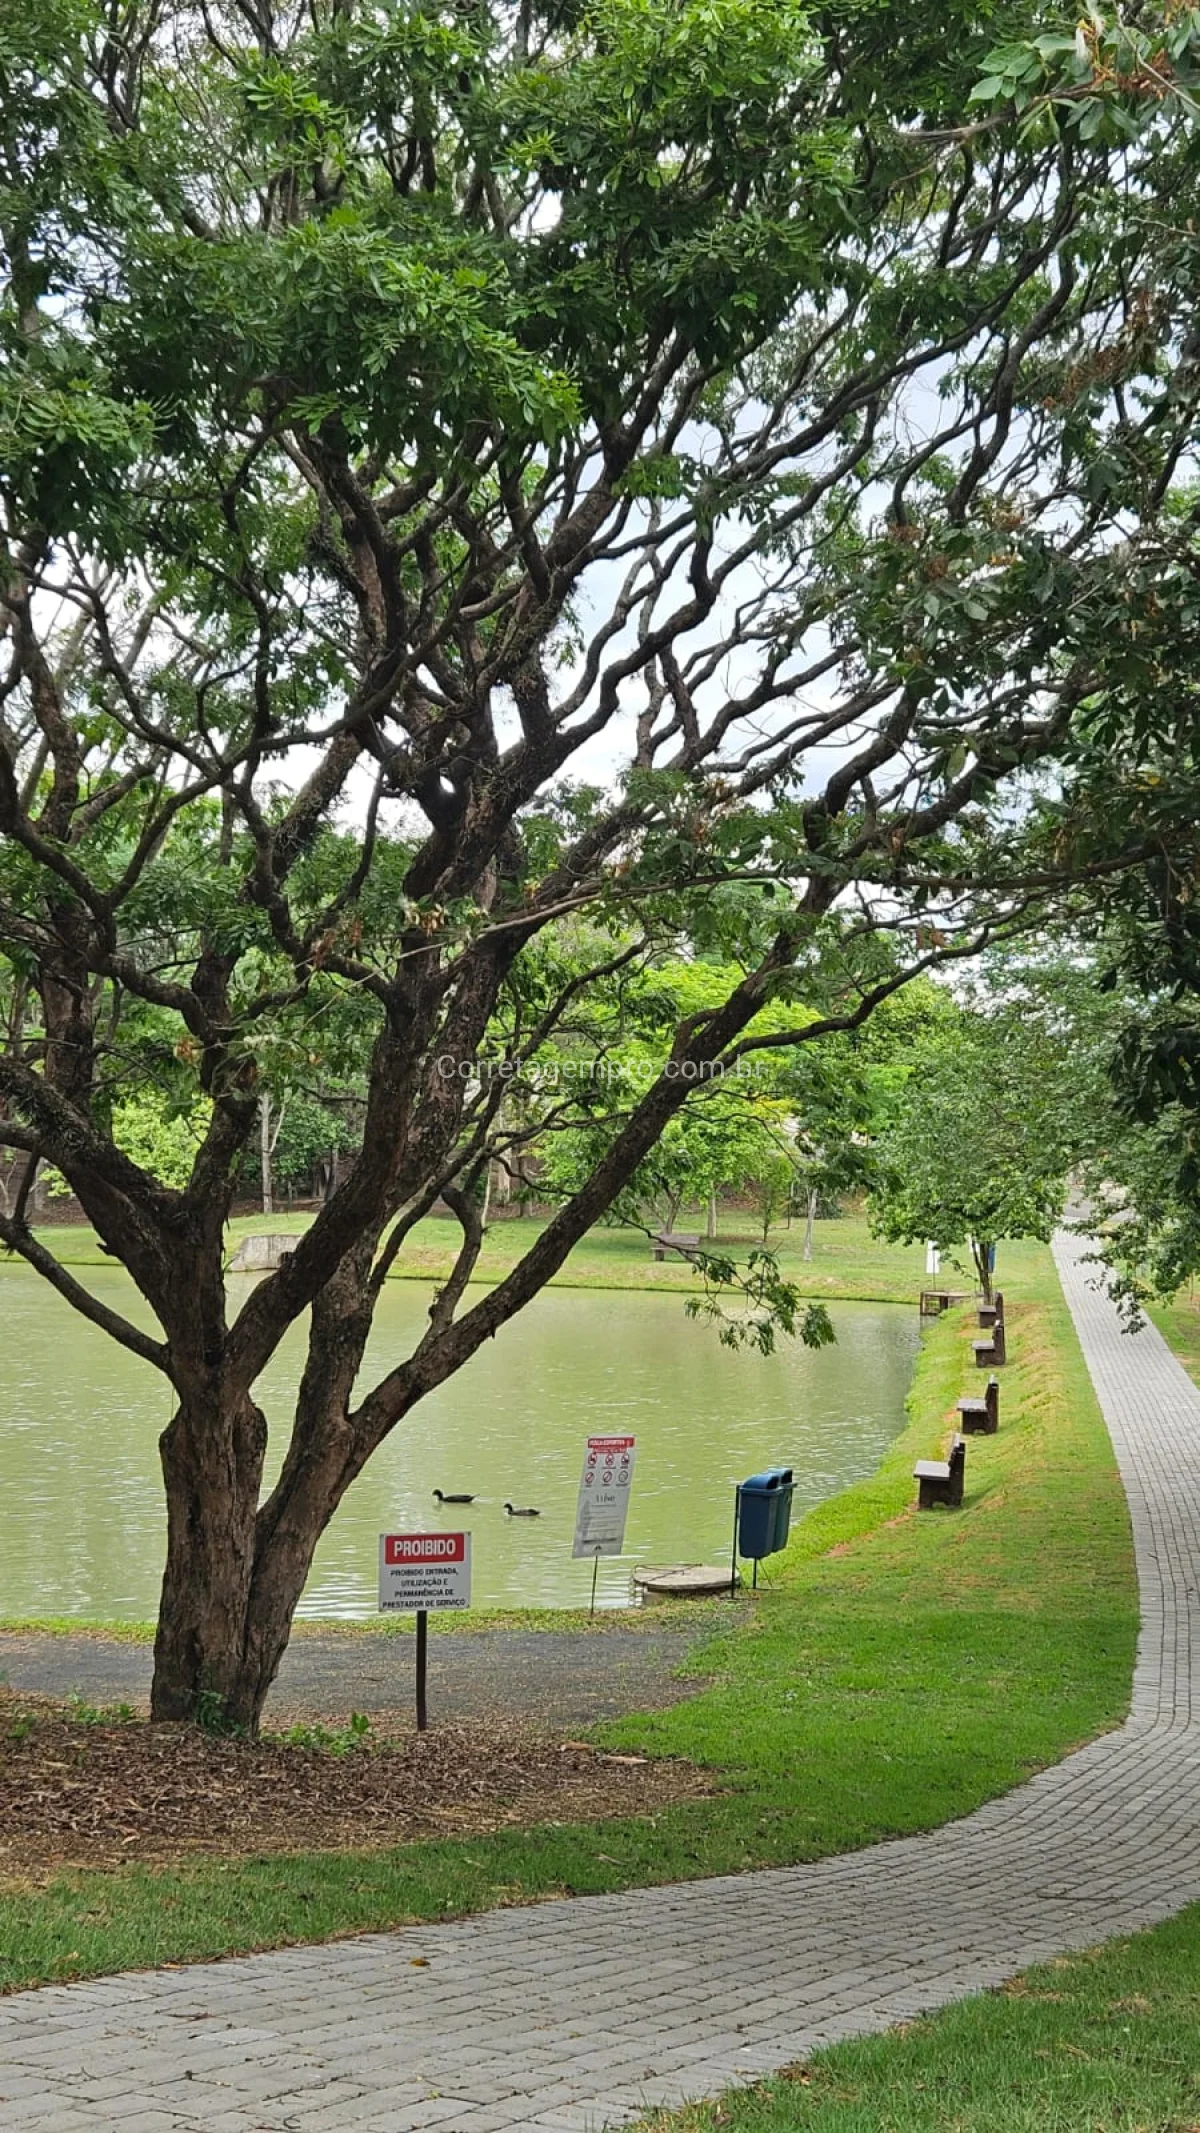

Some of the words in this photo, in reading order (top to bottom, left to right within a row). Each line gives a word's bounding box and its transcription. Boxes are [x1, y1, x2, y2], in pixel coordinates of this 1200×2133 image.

[394, 1539, 456, 1557] PROIBIDO
[390, 1569, 424, 1577] PROIBIDO
[425, 1567, 459, 1576] ENTRADA,
[401, 1578, 442, 1587] UTILIZAÇÃO
[394, 1588, 444, 1597] PERMANÊNCIA
[445, 1588, 454, 1596] DE
[382, 1600, 424, 1608] PRESTADOR
[425, 1599, 434, 1607] DE
[436, 1598, 465, 1607] SERVIÇO
